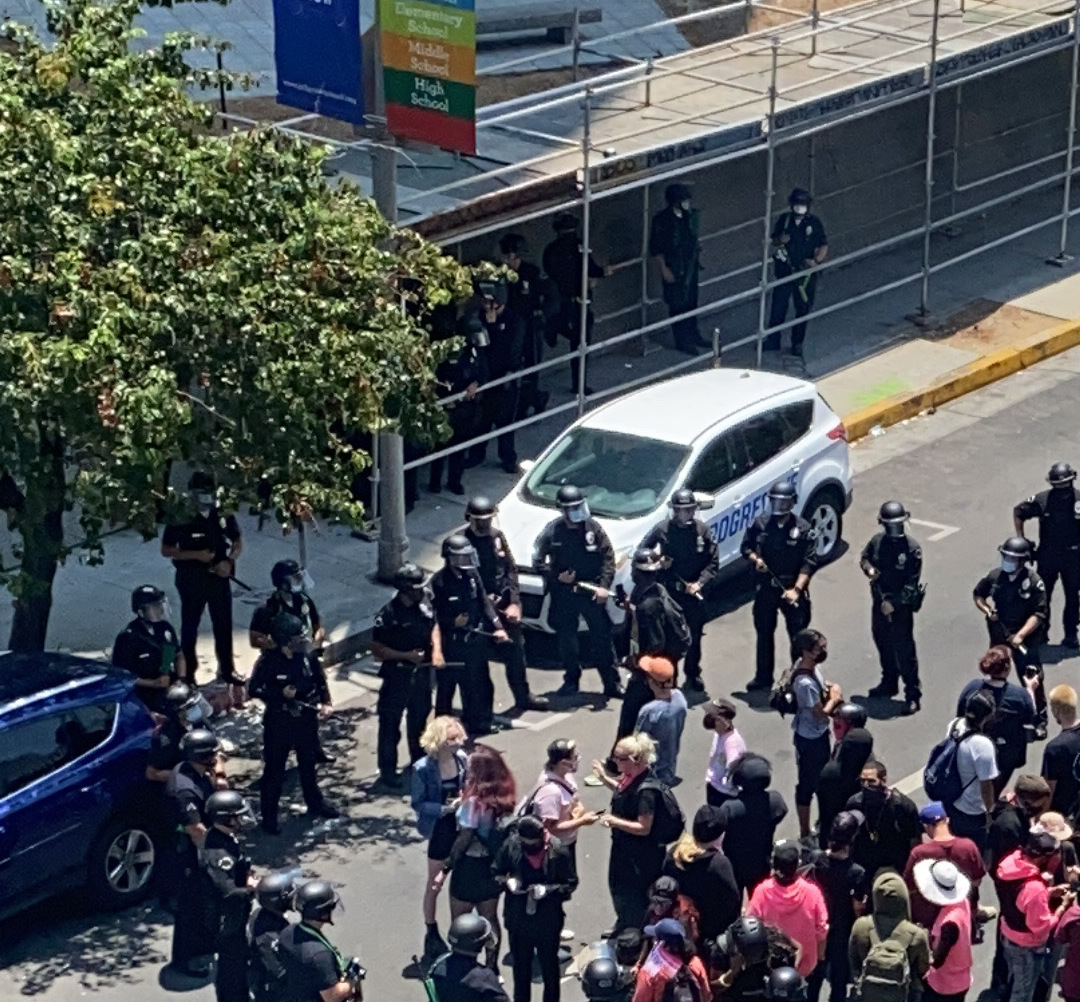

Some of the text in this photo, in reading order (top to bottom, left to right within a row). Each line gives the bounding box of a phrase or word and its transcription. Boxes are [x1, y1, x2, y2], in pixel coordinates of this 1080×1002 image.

[395, 2, 463, 28] Elementary
[408, 20, 448, 39] School
[408, 40, 449, 59] Middle
[410, 56, 449, 76] School
[414, 76, 445, 97] High
[410, 91, 449, 112] School
